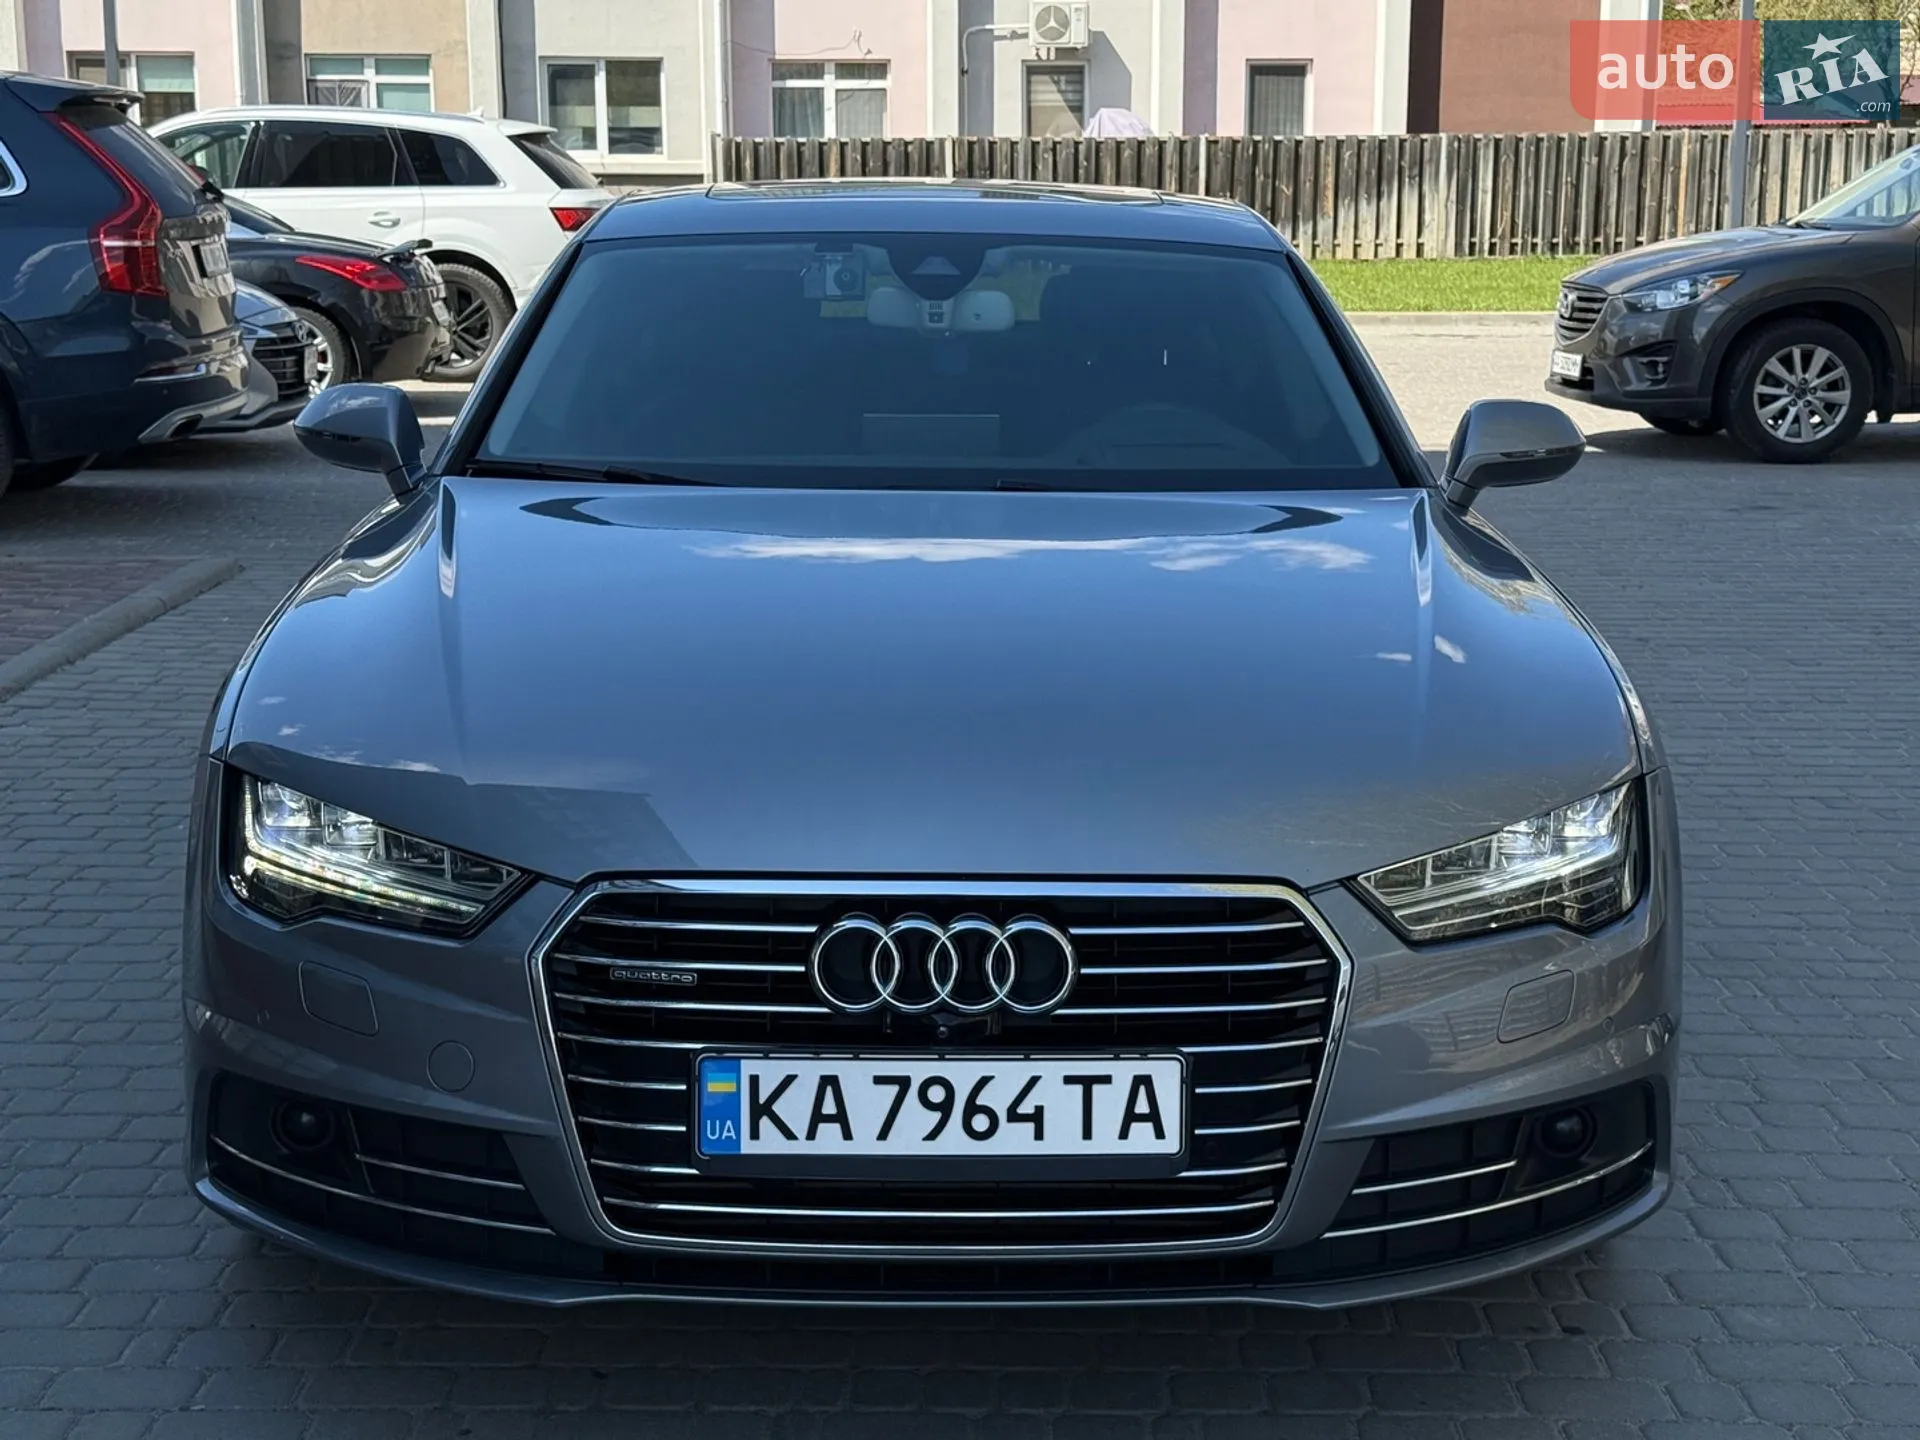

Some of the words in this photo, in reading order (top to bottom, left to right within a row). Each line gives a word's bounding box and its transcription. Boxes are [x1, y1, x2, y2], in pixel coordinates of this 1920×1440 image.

[614, 970, 693, 983] quattro
[749, 1074, 853, 1141] KA
[872, 1075, 1045, 1141] 7964
[1063, 1074, 1166, 1141] TA
[706, 1120, 737, 1140] UA
